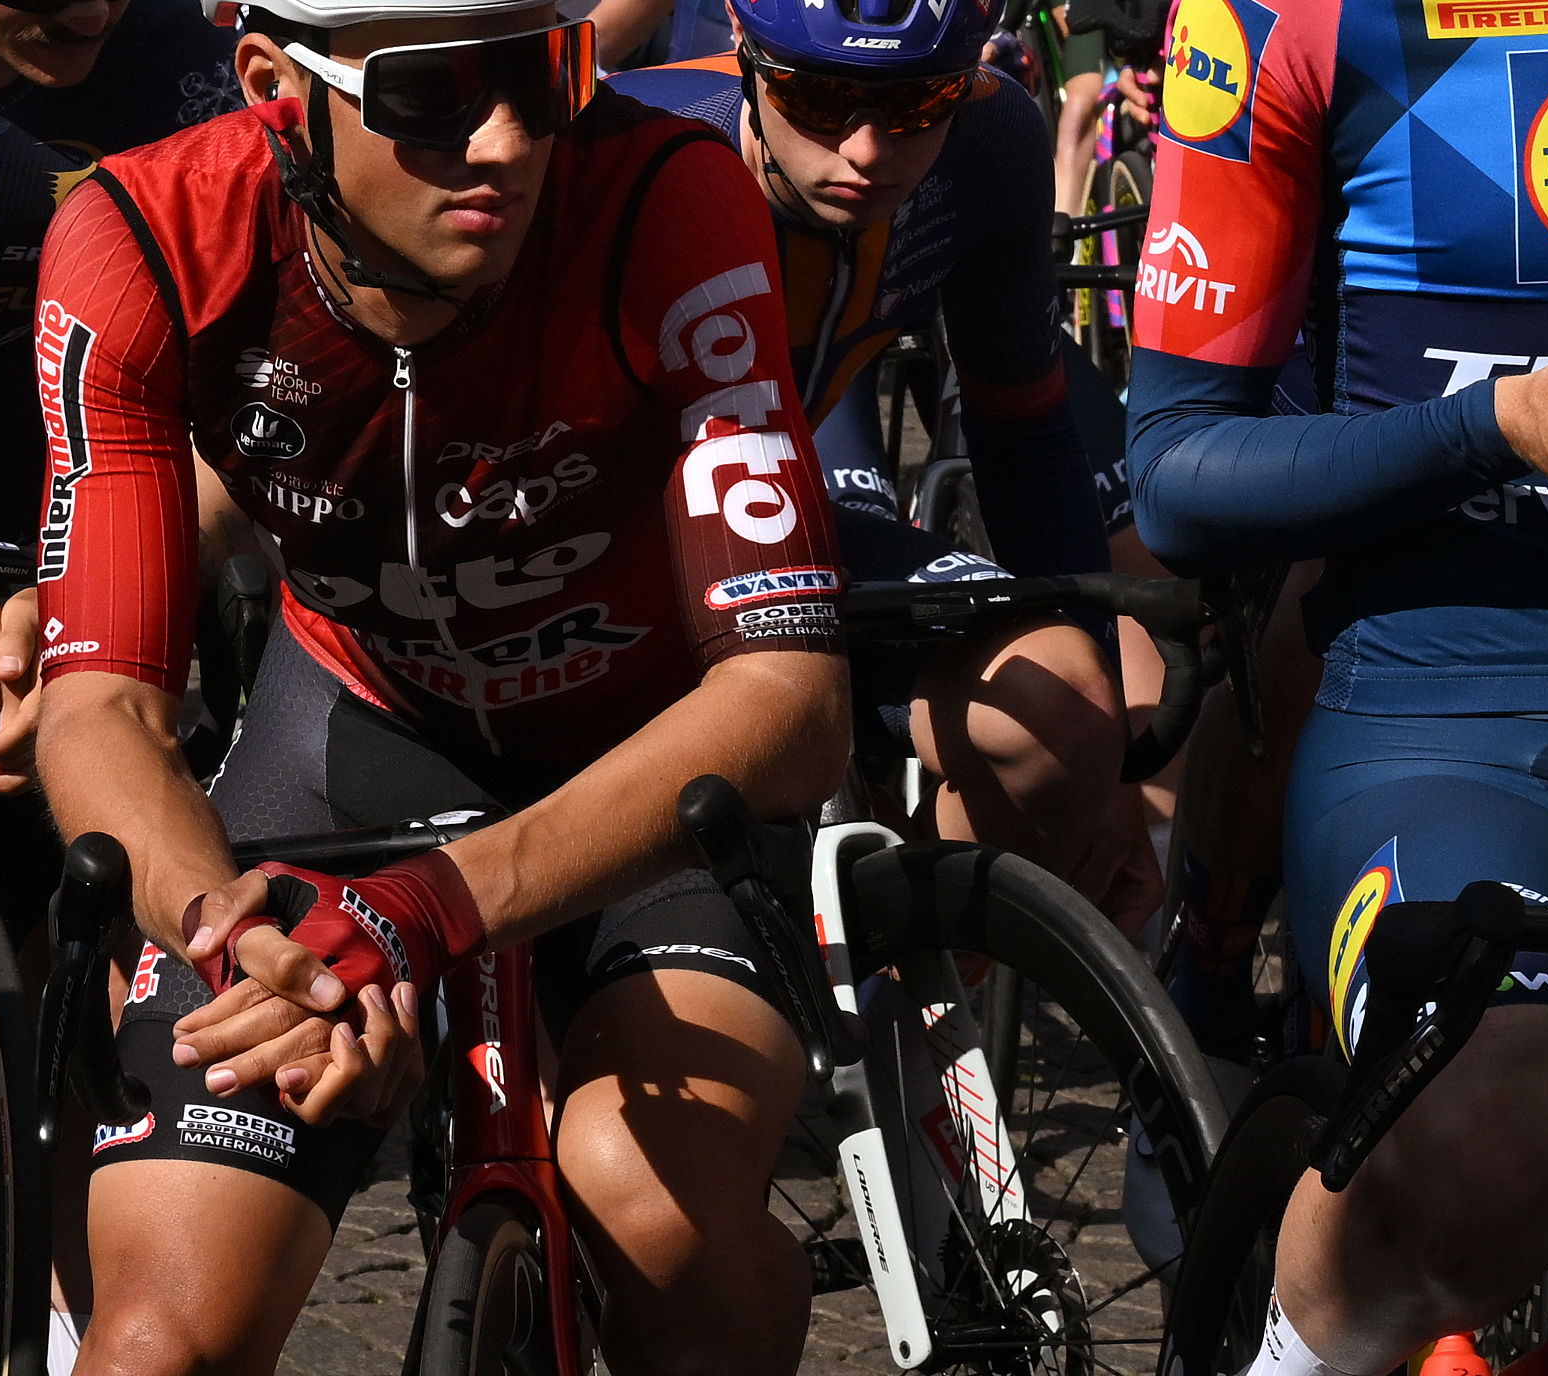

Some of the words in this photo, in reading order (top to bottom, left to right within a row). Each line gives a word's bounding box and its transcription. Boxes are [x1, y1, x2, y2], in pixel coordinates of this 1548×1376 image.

[842, 34, 902, 51] LAZER
[273, 355, 300, 376] UCI
[270, 385, 309, 407] TEAM
[272, 371, 323, 396] WORLD
[658, 261, 800, 545] lotto
[240, 431, 294, 454] vermarc
[249, 475, 365, 526] NIPPO
[434, 451, 600, 529] caps
[725, 570, 835, 600] WANTY
[740, 604, 835, 623] GOBERT
[744, 625, 838, 639] MATERIAUX
[605, 943, 758, 975] ORBEA
[474, 952, 508, 1118] ORBEA
[186, 1107, 293, 1140] GOBERT
[182, 1131, 286, 1165] MATERIAUX
[850, 1152, 890, 1275] LAPIERRE
